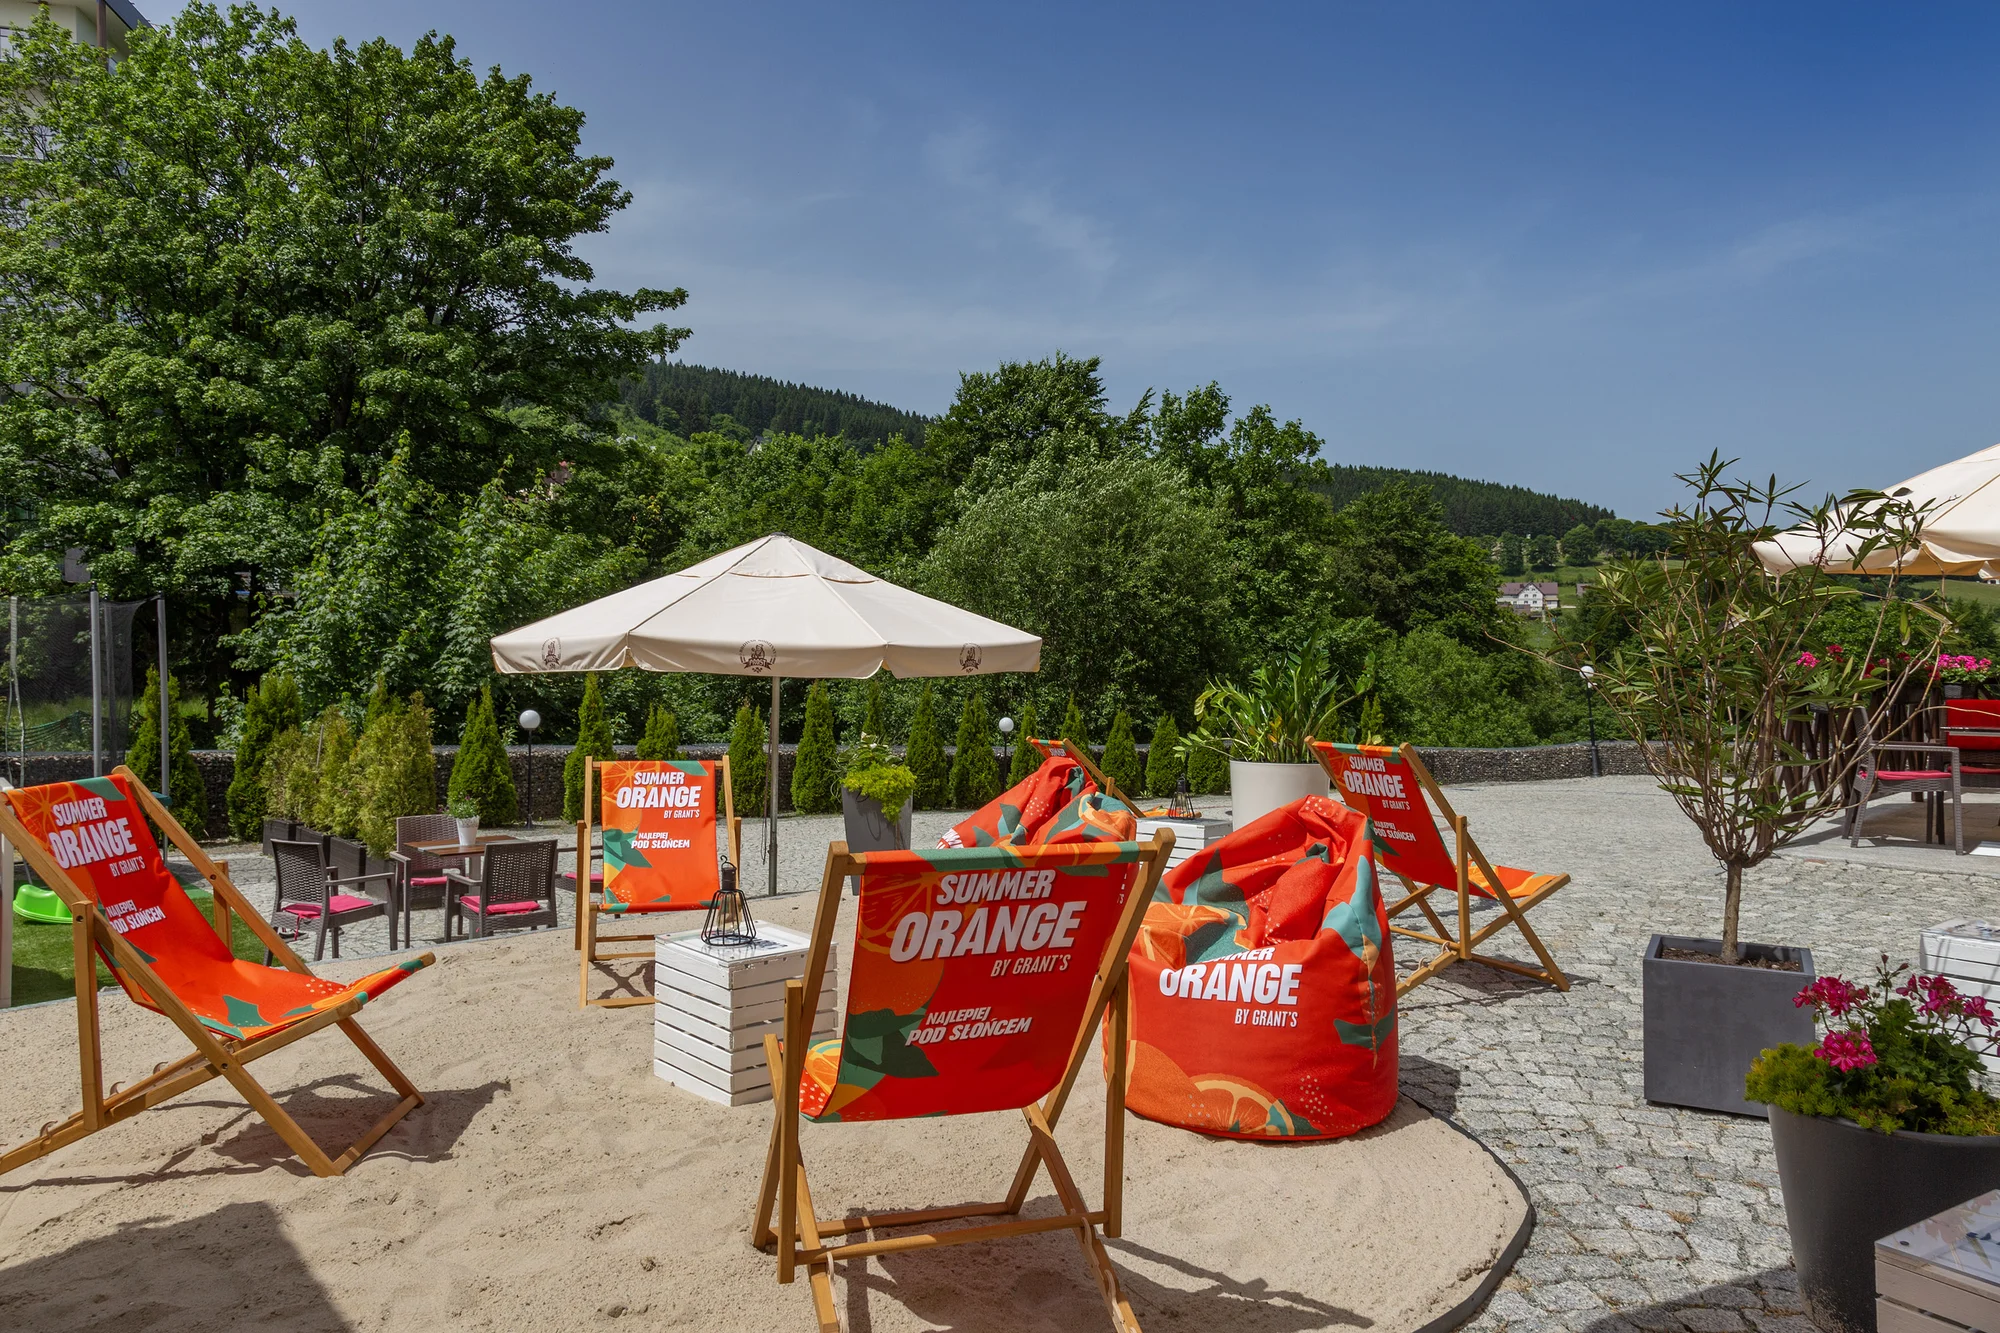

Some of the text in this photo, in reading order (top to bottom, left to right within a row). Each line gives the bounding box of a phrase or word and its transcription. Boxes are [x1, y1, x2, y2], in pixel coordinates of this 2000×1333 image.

[1349, 756, 1385, 772] SUMMER
[633, 771, 685, 785] SUMMER
[1343, 771, 1406, 798] ORANGE
[616, 786, 701, 808] ORANGE
[1382, 799, 1389, 809] BY
[52, 797, 108, 827] SUMMER
[663, 809, 700, 818] BY GRANT'S
[48, 817, 138, 869] ORANGE
[638, 832, 669, 840] NAJLEPIEJ
[1373, 827, 1387, 838] POD
[631, 838, 690, 849] POD SŁOŃCEM
[109, 856, 146, 877] BY GRANT'S
[936, 869, 1056, 905] SUMMER
[126, 906, 166, 929] SŁOŃCEM
[889, 900, 1088, 962] ORANGE
[990, 954, 1071, 977] BY GRANT'S
[1159, 962, 1303, 1005] ORANGE
[925, 1006, 991, 1026] NAJLEPIEJ
[1234, 1008, 1298, 1028] BY GRANT'S
[905, 1017, 1032, 1046] POD SŁOŃCEM
